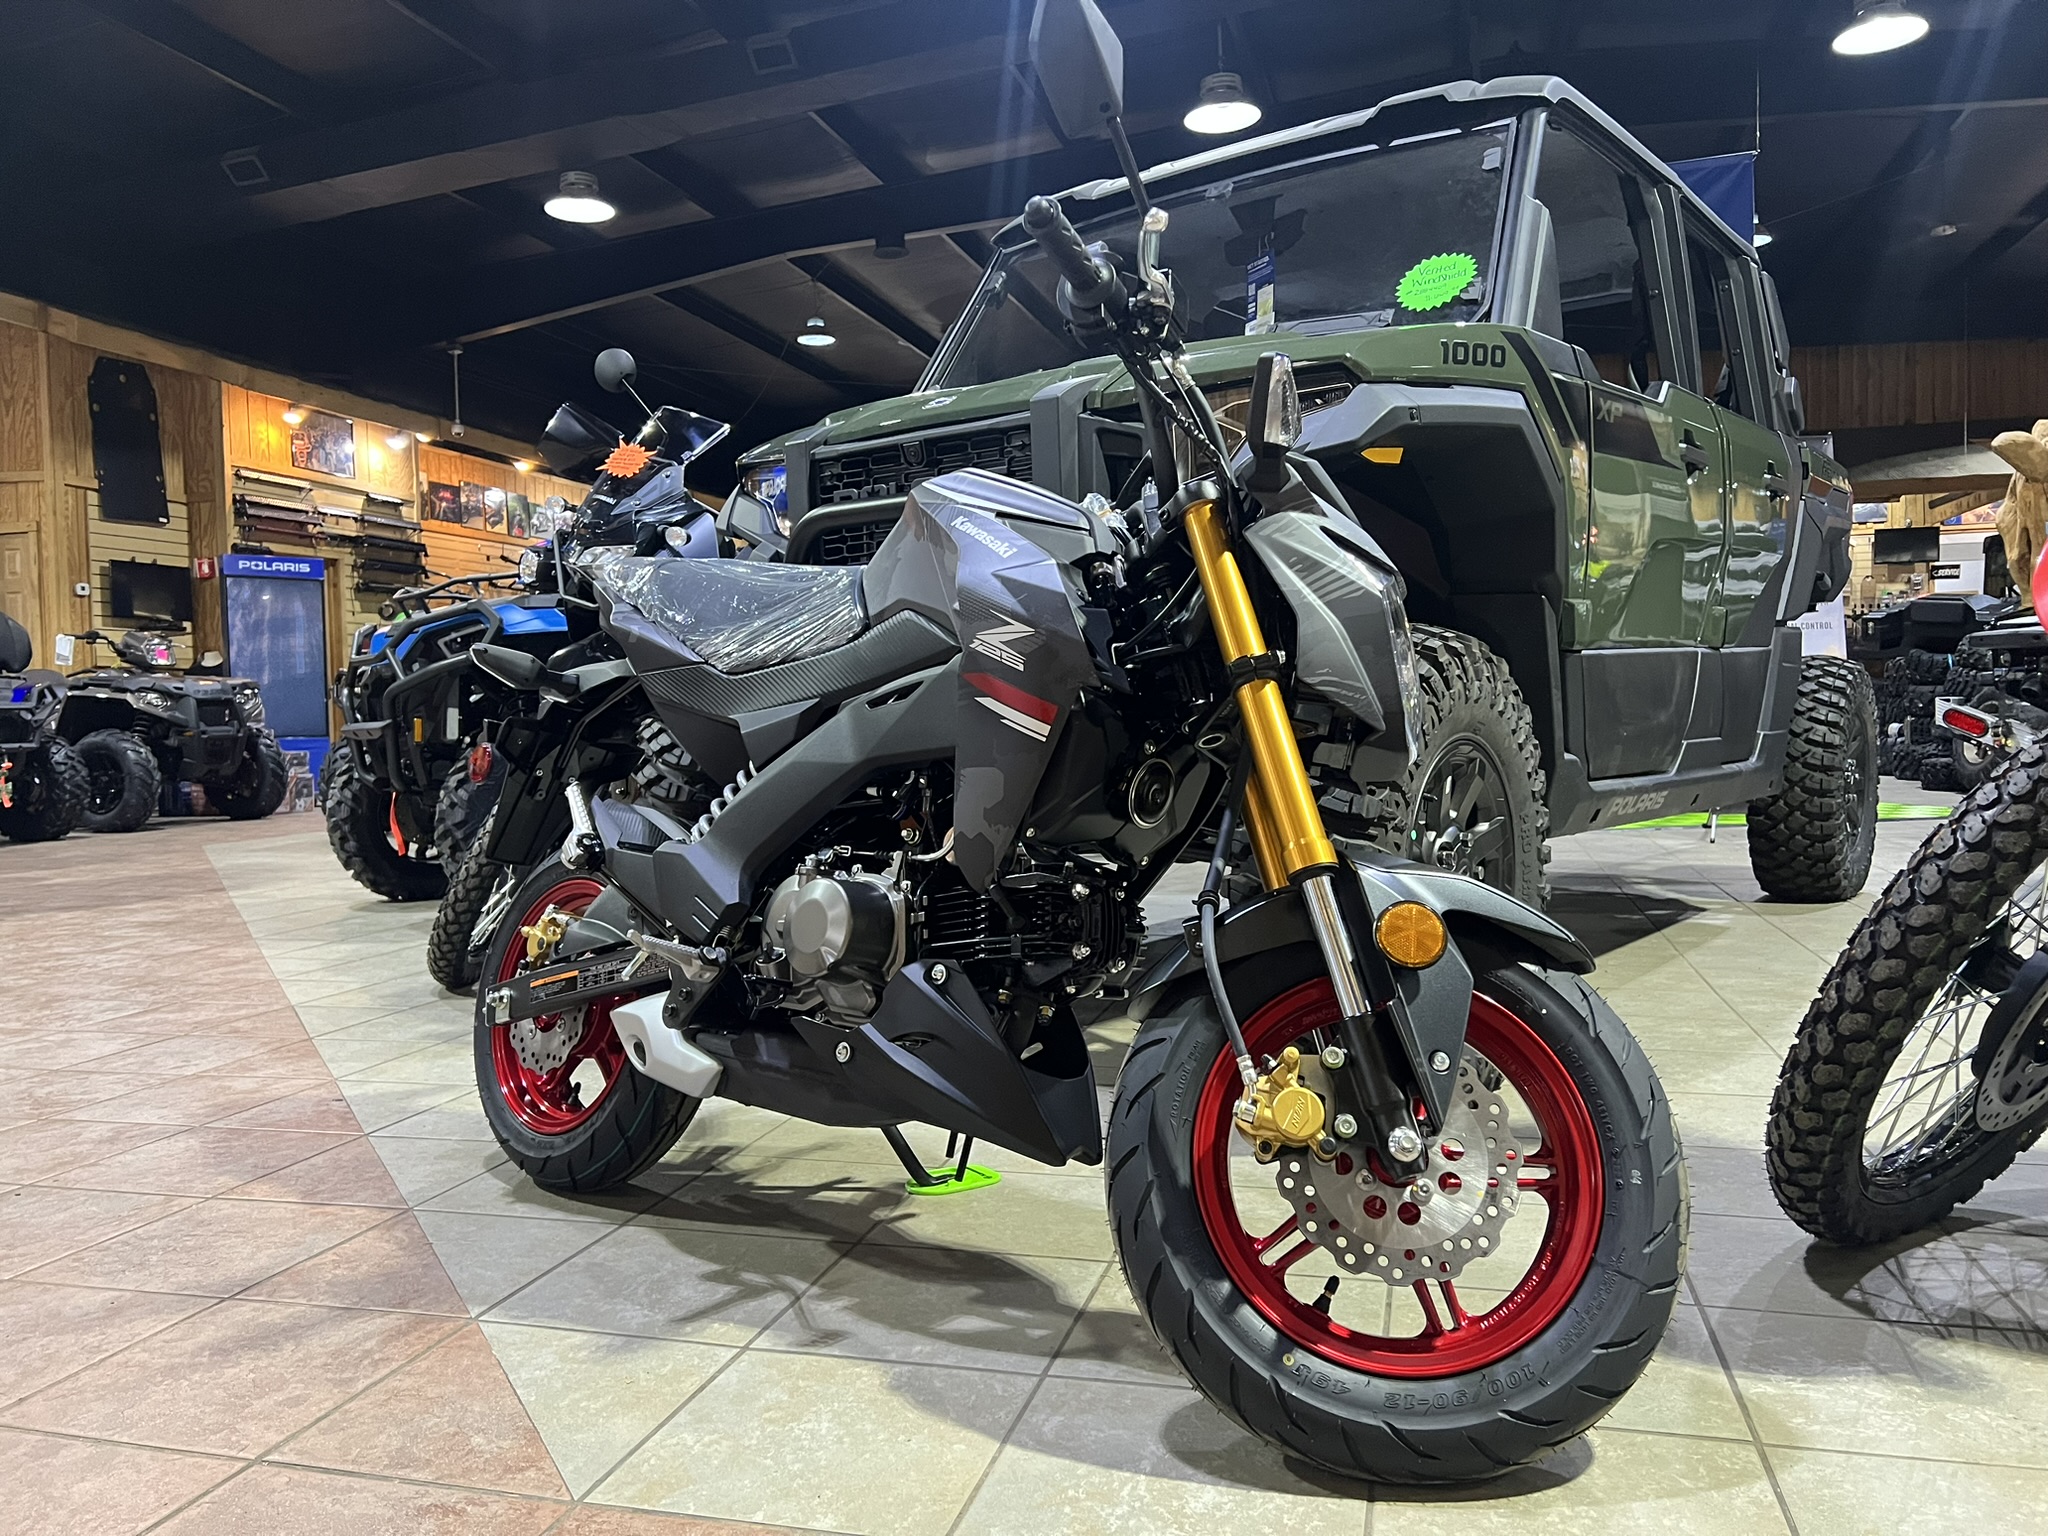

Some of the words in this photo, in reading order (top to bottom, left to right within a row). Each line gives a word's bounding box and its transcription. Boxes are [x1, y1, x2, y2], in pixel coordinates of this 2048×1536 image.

[1418, 261, 1457, 276] Vented
[1440, 339, 1506, 368] 1000
[1596, 397, 1623, 423] XP
[951, 515, 1018, 559] Kawasaki
[238, 560, 311, 573] POLARIS
[1937, 568, 1960, 577] SERVICE
[1800, 621, 1834, 630] CONTROL
[1606, 790, 1669, 817] POLARIS
[1565, 1045, 1583, 1068] DOT
[1291, 1363, 1352, 1395] 49J
[1384, 1363, 1536, 1410] 100/90-12
